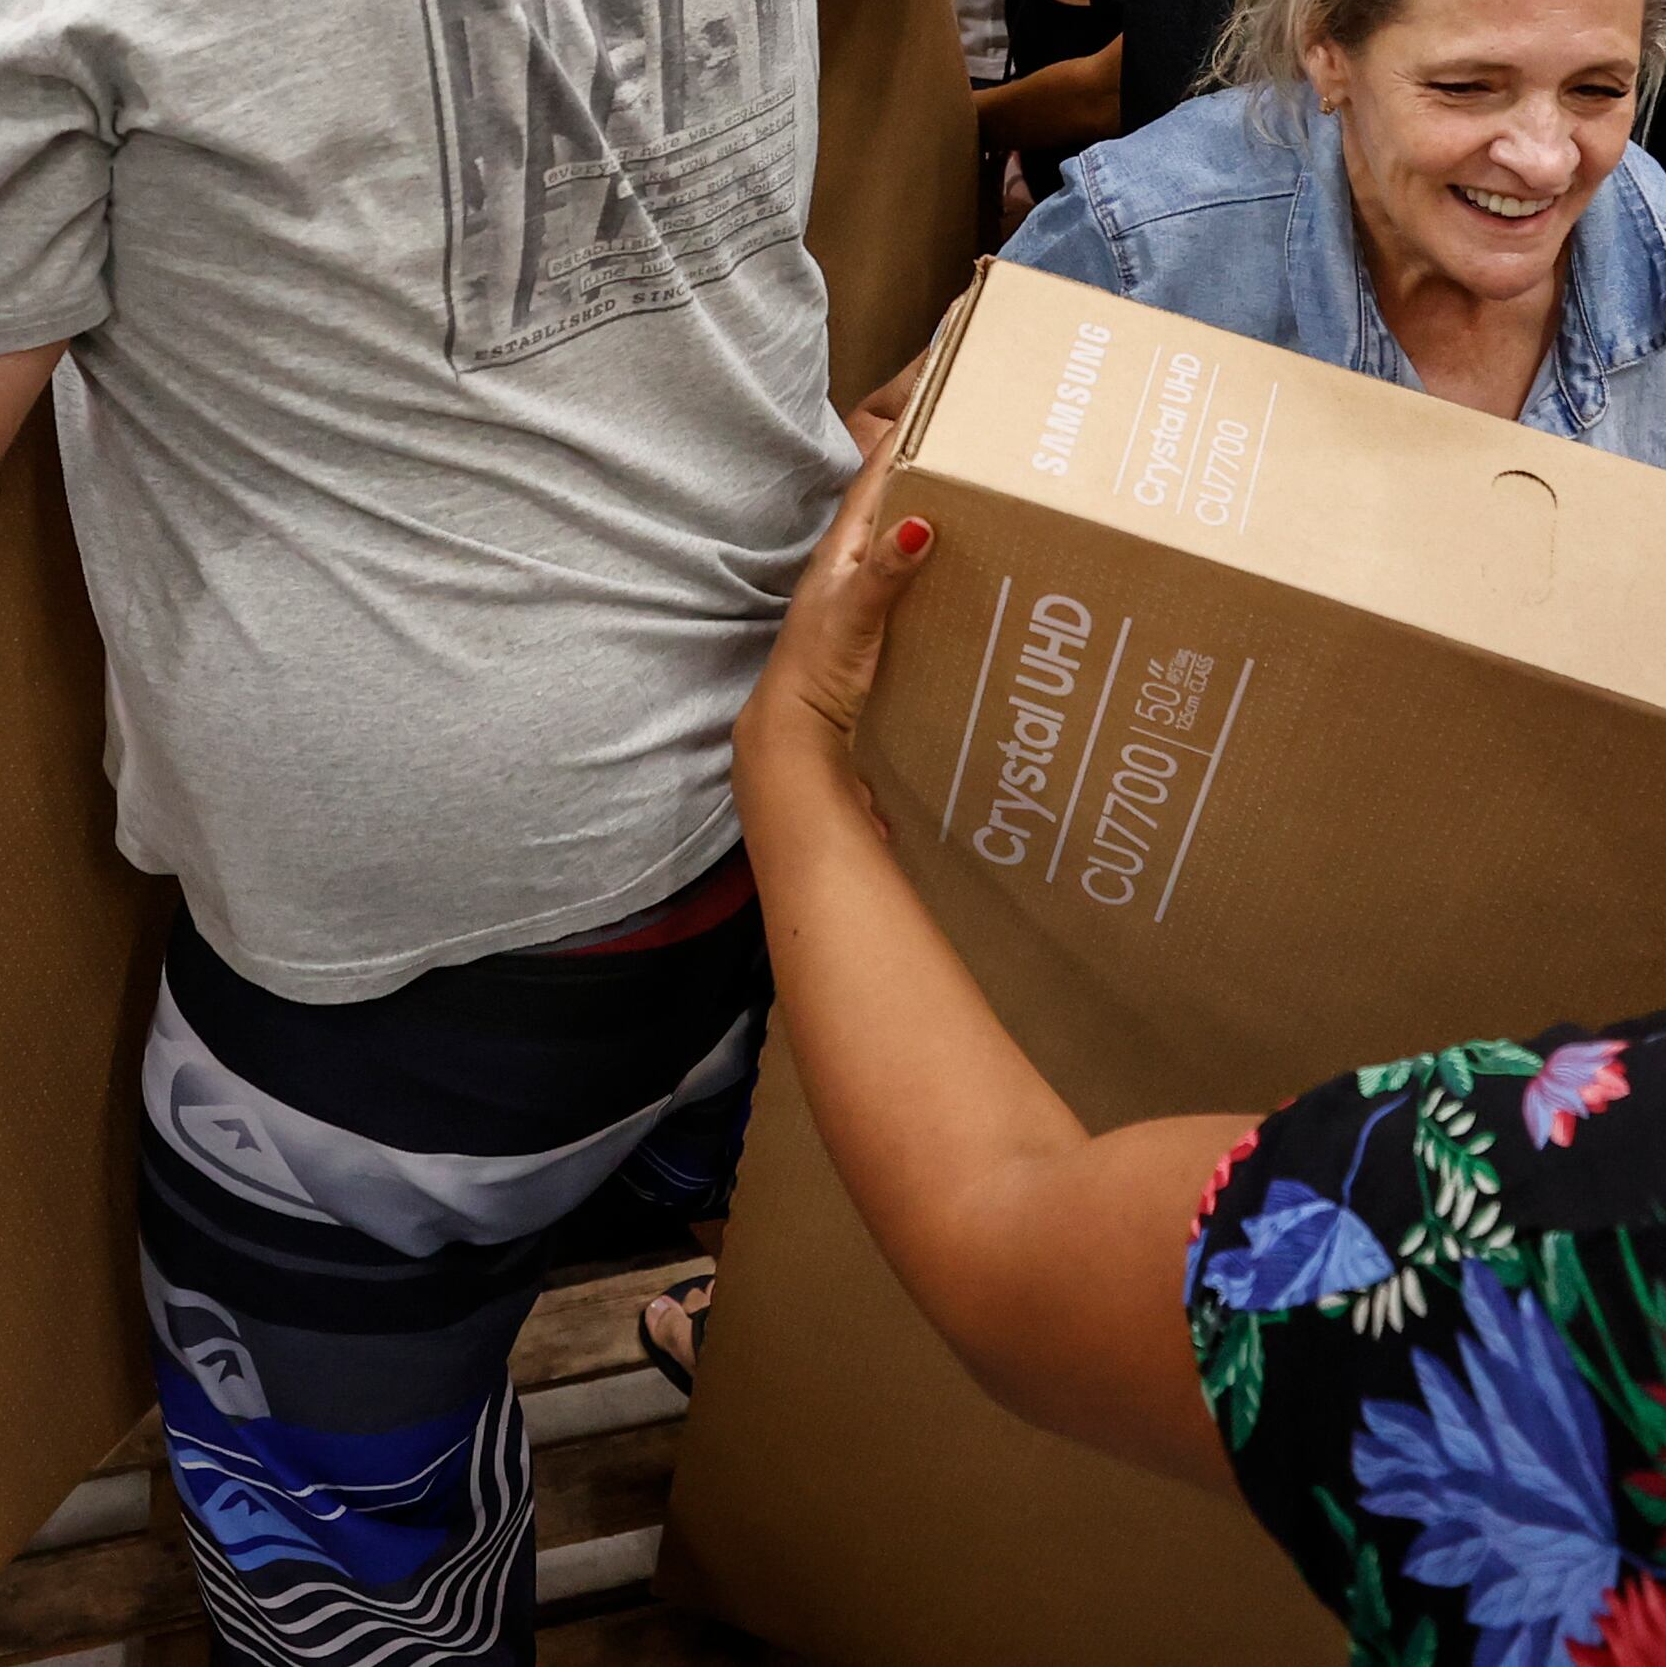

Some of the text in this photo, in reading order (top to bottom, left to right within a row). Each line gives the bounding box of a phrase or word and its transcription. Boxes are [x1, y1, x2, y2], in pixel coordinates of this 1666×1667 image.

[473, 295, 617, 363] ESTABLISHED
[1033, 321, 1112, 477] SAMSUNG
[1134, 351, 1201, 508] Crystal UHD
[1194, 419, 1249, 526] CU7700
[972, 593, 1093, 866] Crystal UHD
[1079, 743, 1179, 906] CU7700
